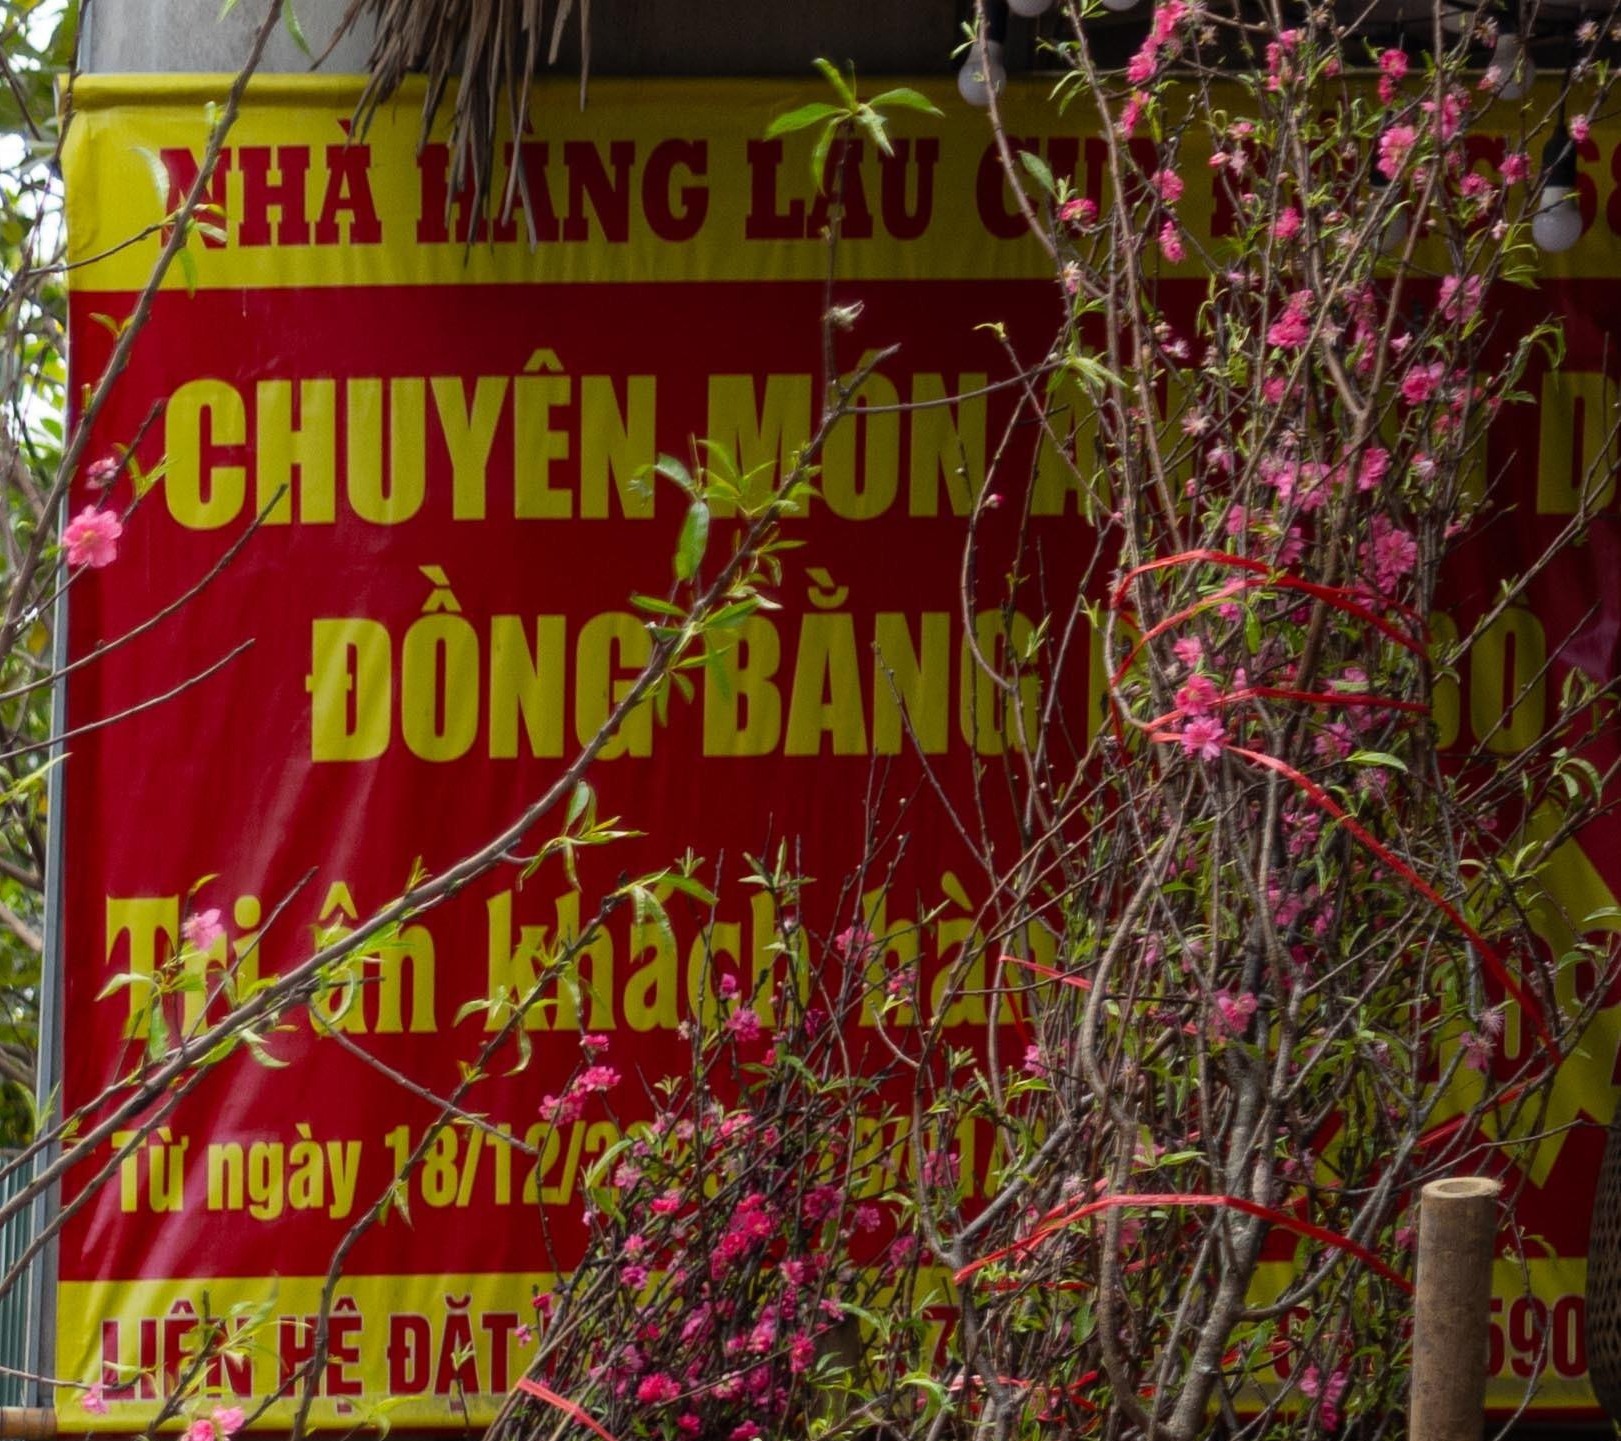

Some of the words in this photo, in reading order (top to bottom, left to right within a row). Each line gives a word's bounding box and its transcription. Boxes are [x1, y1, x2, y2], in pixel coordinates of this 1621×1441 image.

[160, 119, 382, 250] NHÀ
[163, 347, 656, 530] CHUYÊN
[706, 341, 988, 522] MÓN
[306, 565, 645, 766] ĐỒNG
[702, 563, 1039, 762] BẰNG
[106, 895, 264, 1036] Tri
[486, 883, 815, 1034] khách
[857, 872, 1061, 1028] hàn
[111, 1127, 190, 1214] Từ
[207, 1123, 363, 1221] ngày
[102, 1298, 253, 1399] LIÊN
[278, 1293, 363, 1414] HỆ
[388, 1293, 520, 1413] ĐẶT
